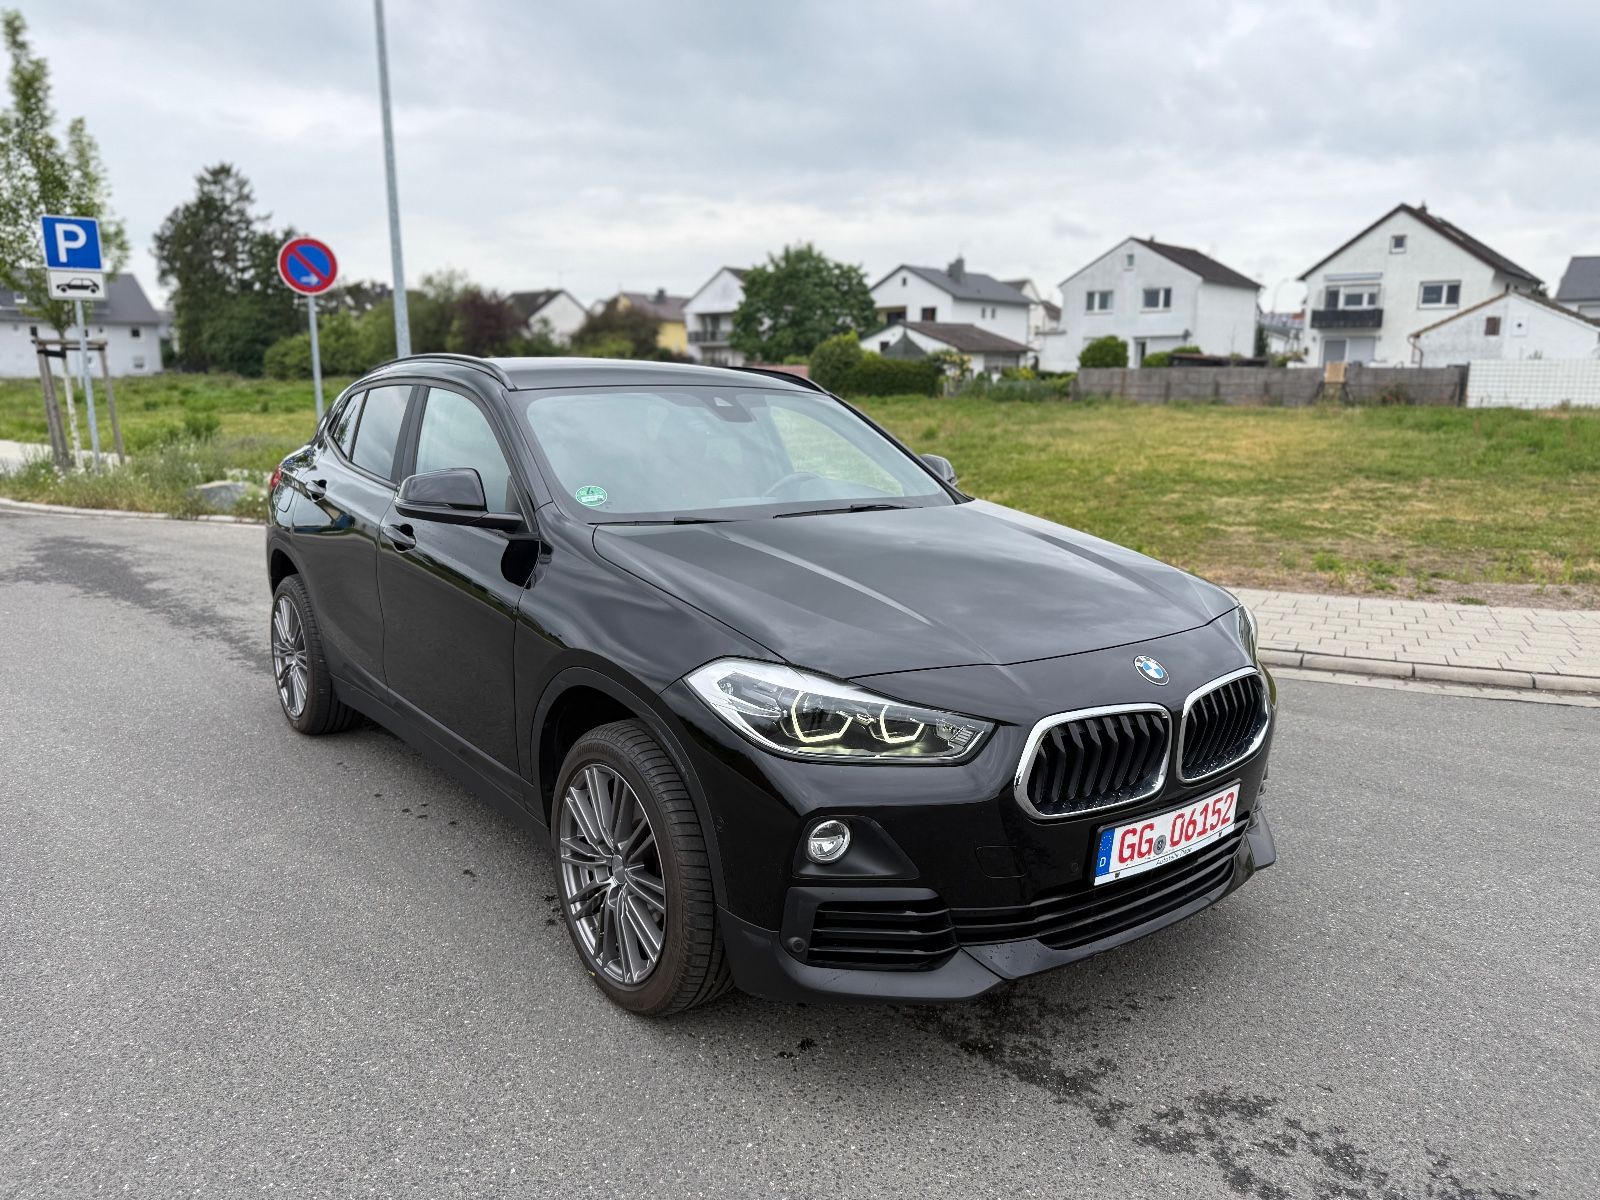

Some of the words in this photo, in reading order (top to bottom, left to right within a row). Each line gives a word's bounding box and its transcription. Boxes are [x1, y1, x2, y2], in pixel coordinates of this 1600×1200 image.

[55, 223, 87, 263] P
[1118, 823, 1155, 864] GG
[1170, 791, 1235, 847] 06152
[1099, 857, 1106, 867] D
